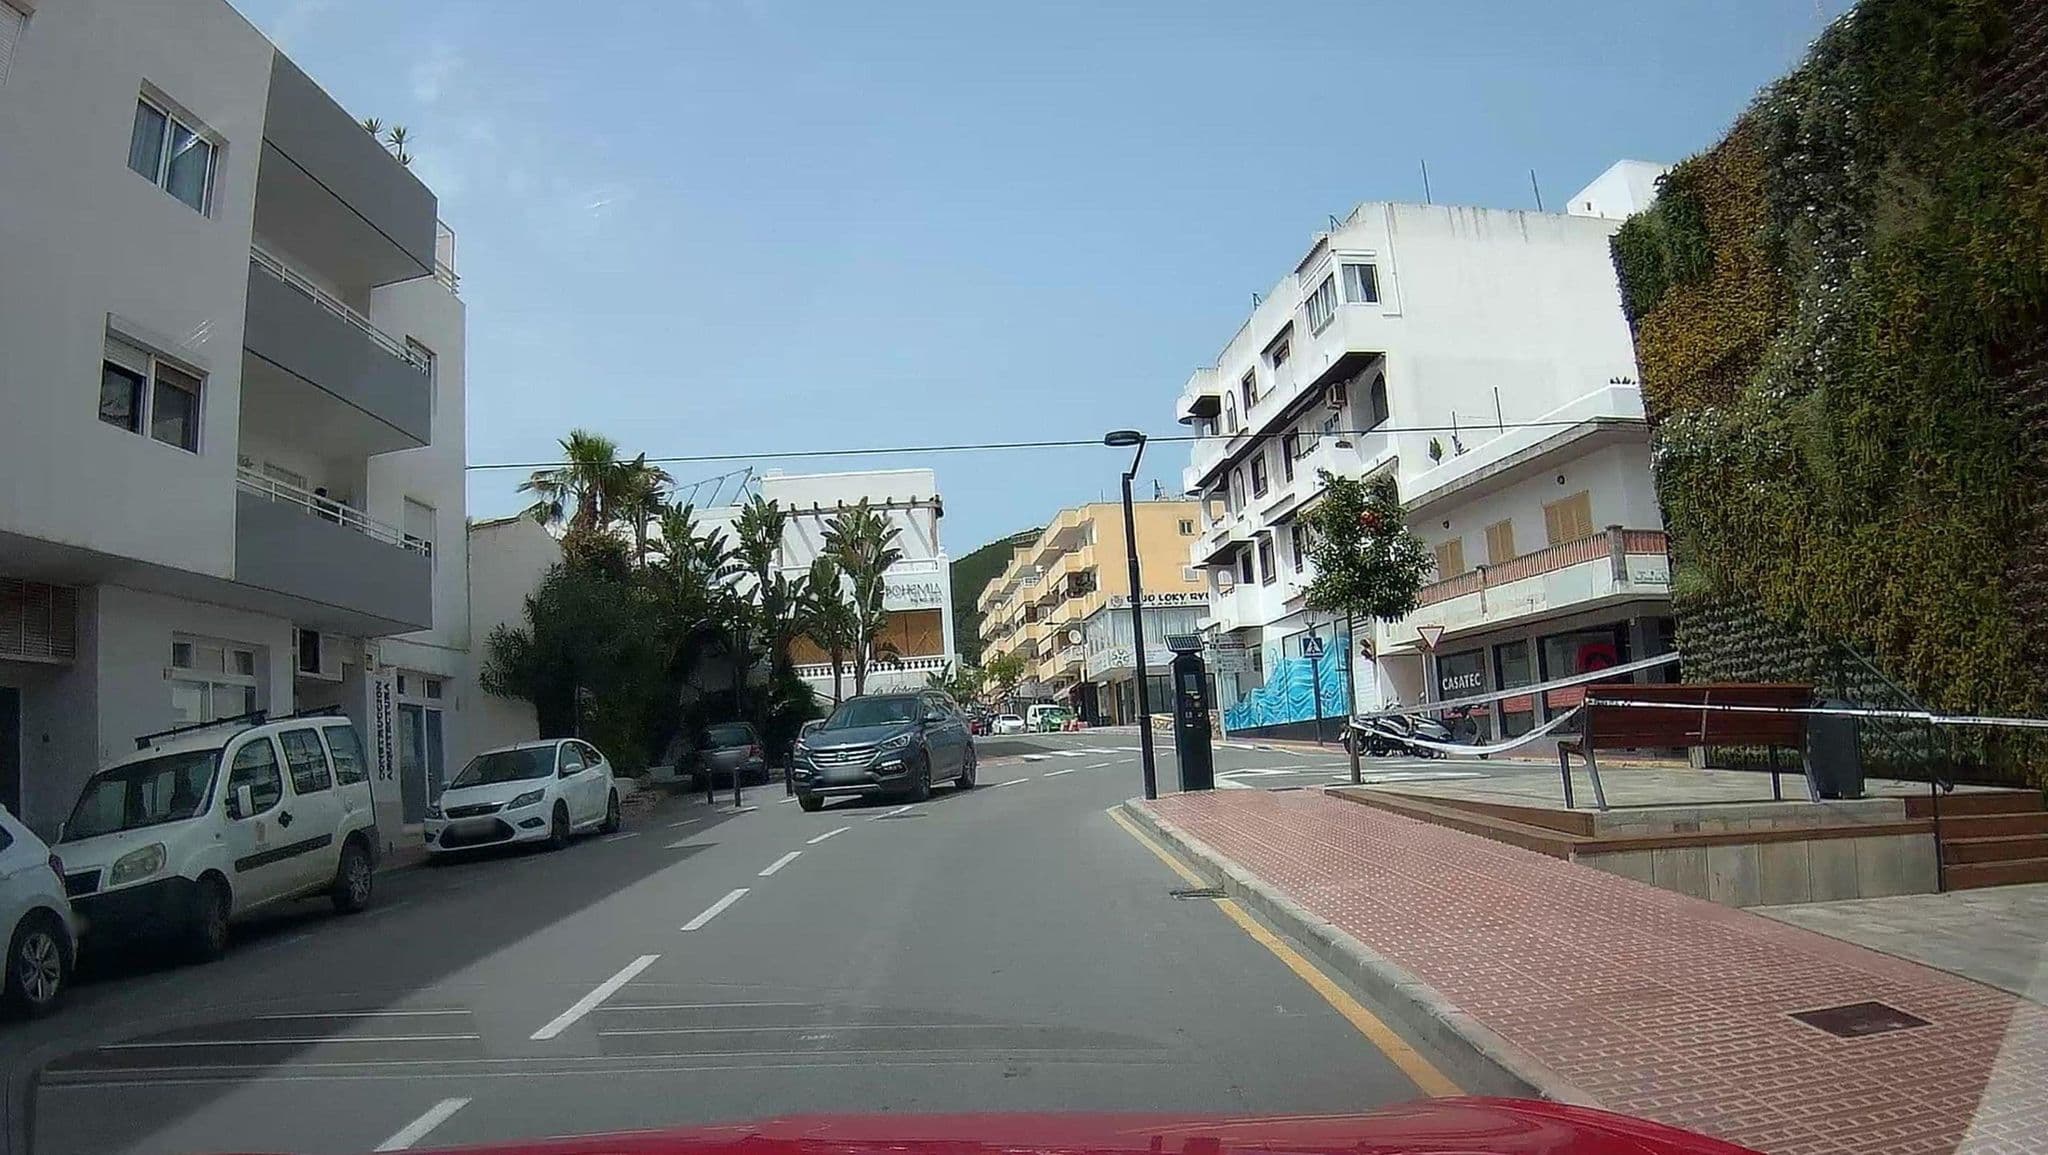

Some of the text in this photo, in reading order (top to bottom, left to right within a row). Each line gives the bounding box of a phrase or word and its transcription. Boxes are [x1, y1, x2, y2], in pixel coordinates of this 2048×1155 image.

[885, 583, 942, 598] BOHEMIA
[1158, 592, 1187, 602] LOKY
[1442, 673, 1481, 690] CASATEC
